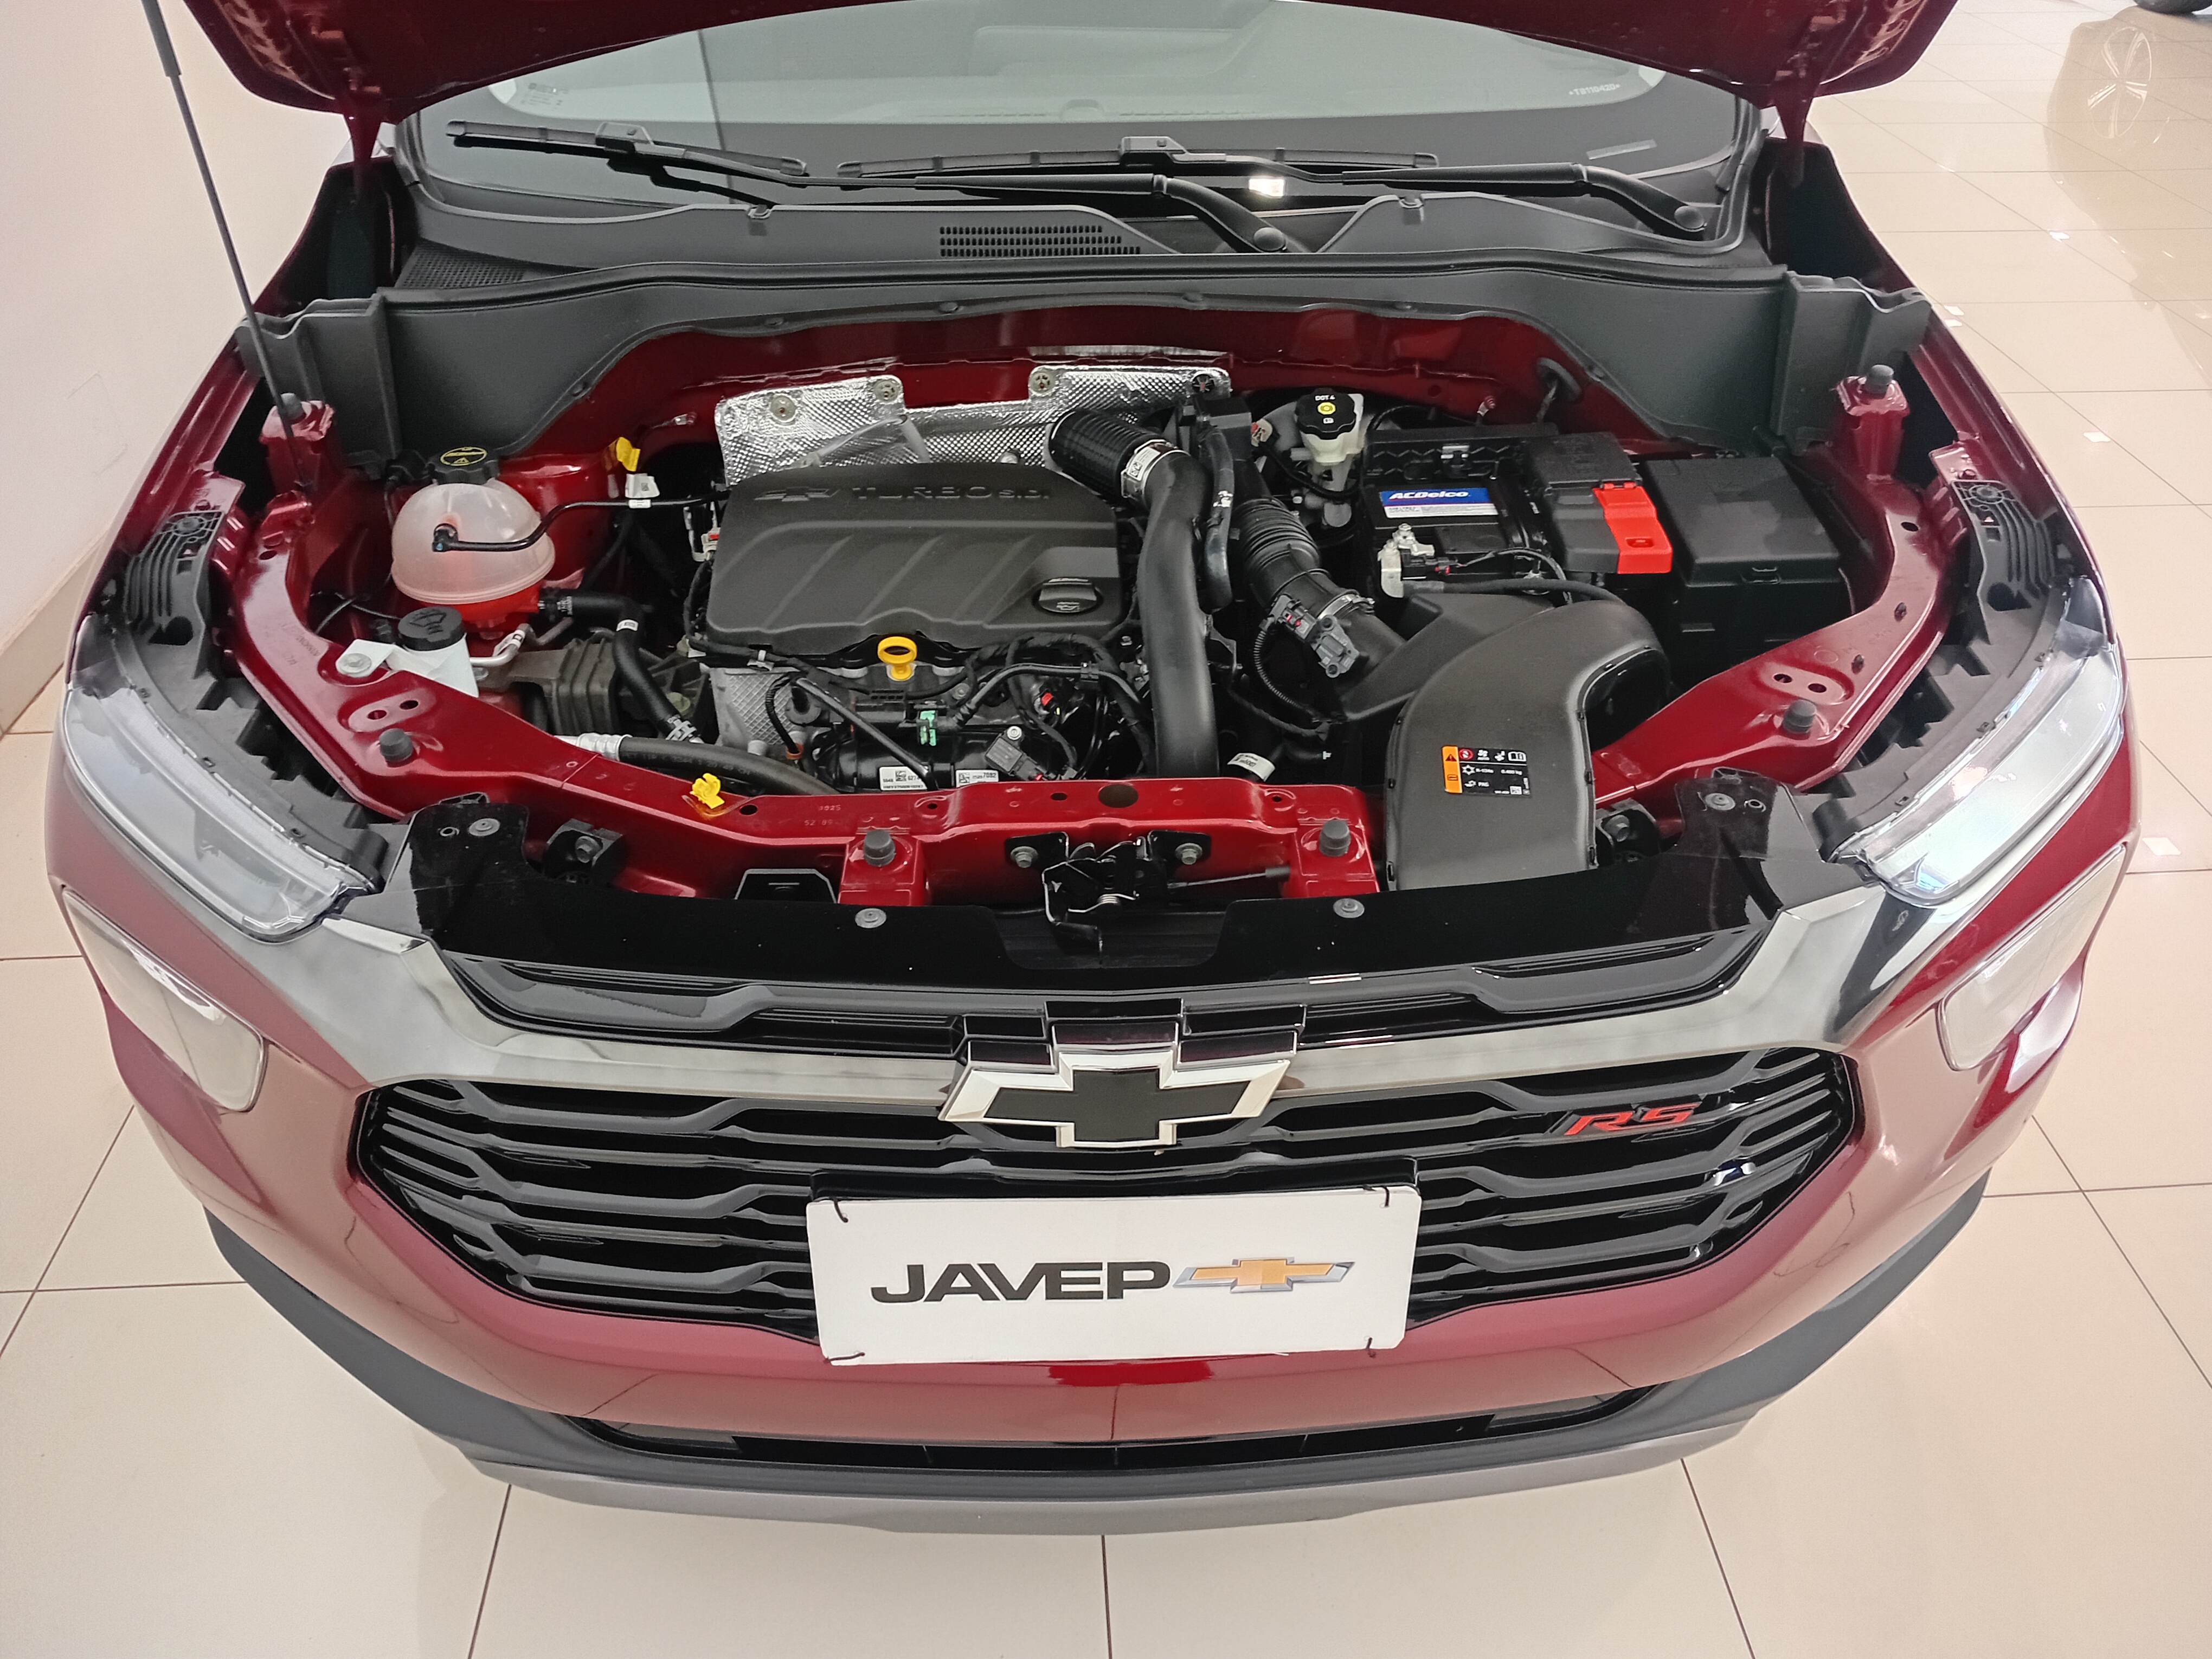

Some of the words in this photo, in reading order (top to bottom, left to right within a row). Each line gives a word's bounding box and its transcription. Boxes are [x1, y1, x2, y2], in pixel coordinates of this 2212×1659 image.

[852, 487, 992, 499] TURBO
[1389, 491, 1469, 499] ACDelco
[1564, 1101, 1702, 1135] RS
[871, 1261, 1171, 1303] JAVEP
